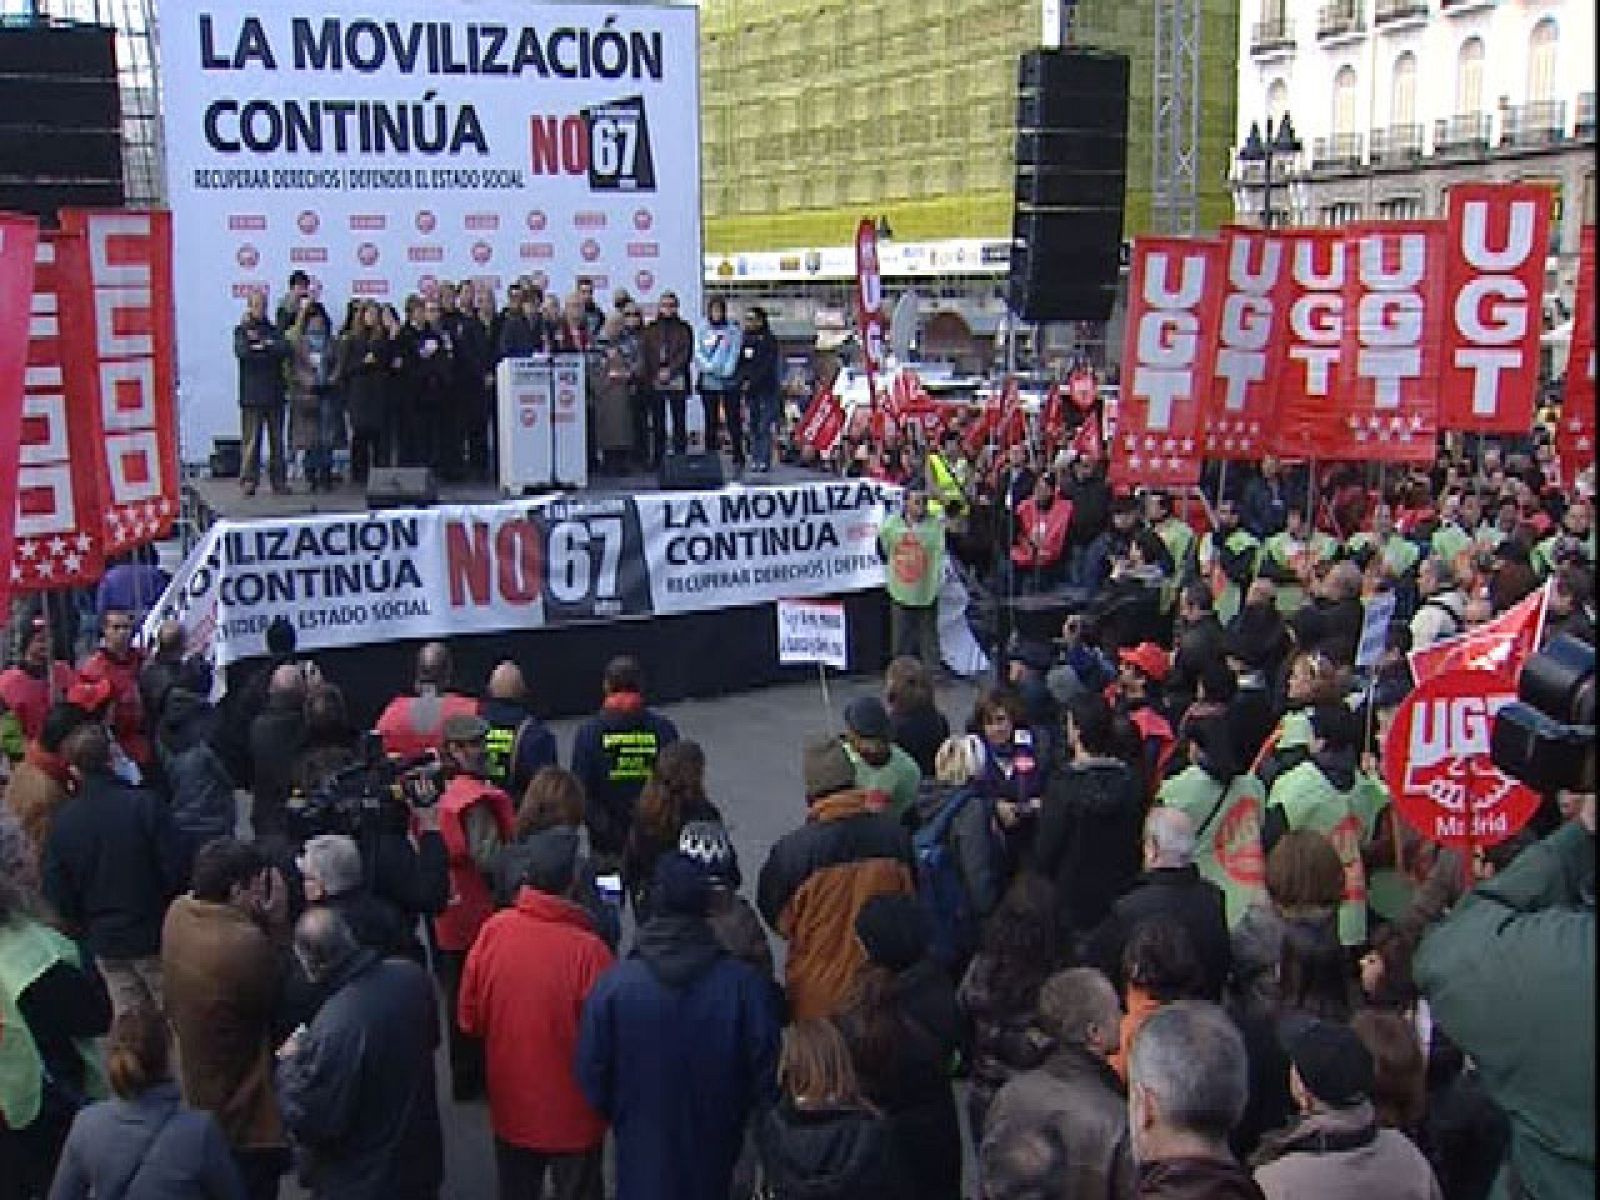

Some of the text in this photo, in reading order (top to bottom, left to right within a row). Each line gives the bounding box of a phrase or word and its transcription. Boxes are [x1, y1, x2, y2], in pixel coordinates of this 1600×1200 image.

[199, 14, 664, 81] LA MOVILIZACIÓN
[203, 91, 489, 155] CONTINÚA
[531, 115, 637, 176] NO 67
[194, 169, 526, 190] RECUPERAR DERECHOS DEFENDER EL ESTADO SOCIAL
[1213, 234, 1283, 411] UGT
[1289, 241, 1346, 396] UGT
[1357, 234, 1426, 409] UGT
[1453, 201, 1536, 415] UGT
[88, 214, 162, 504] CCOO
[1131, 252, 1206, 431] UGT
[664, 499, 709, 529] LA
[665, 518, 840, 566] CONTINÚA
[219, 554, 423, 606] CONTINÚA
[446, 519, 621, 606] NO 67
[666, 568, 751, 593] RECUPERAR
[754, 559, 825, 584] DERECHOS
[299, 603, 368, 630] ESTADO
[371, 599, 432, 622] SOCIAL
